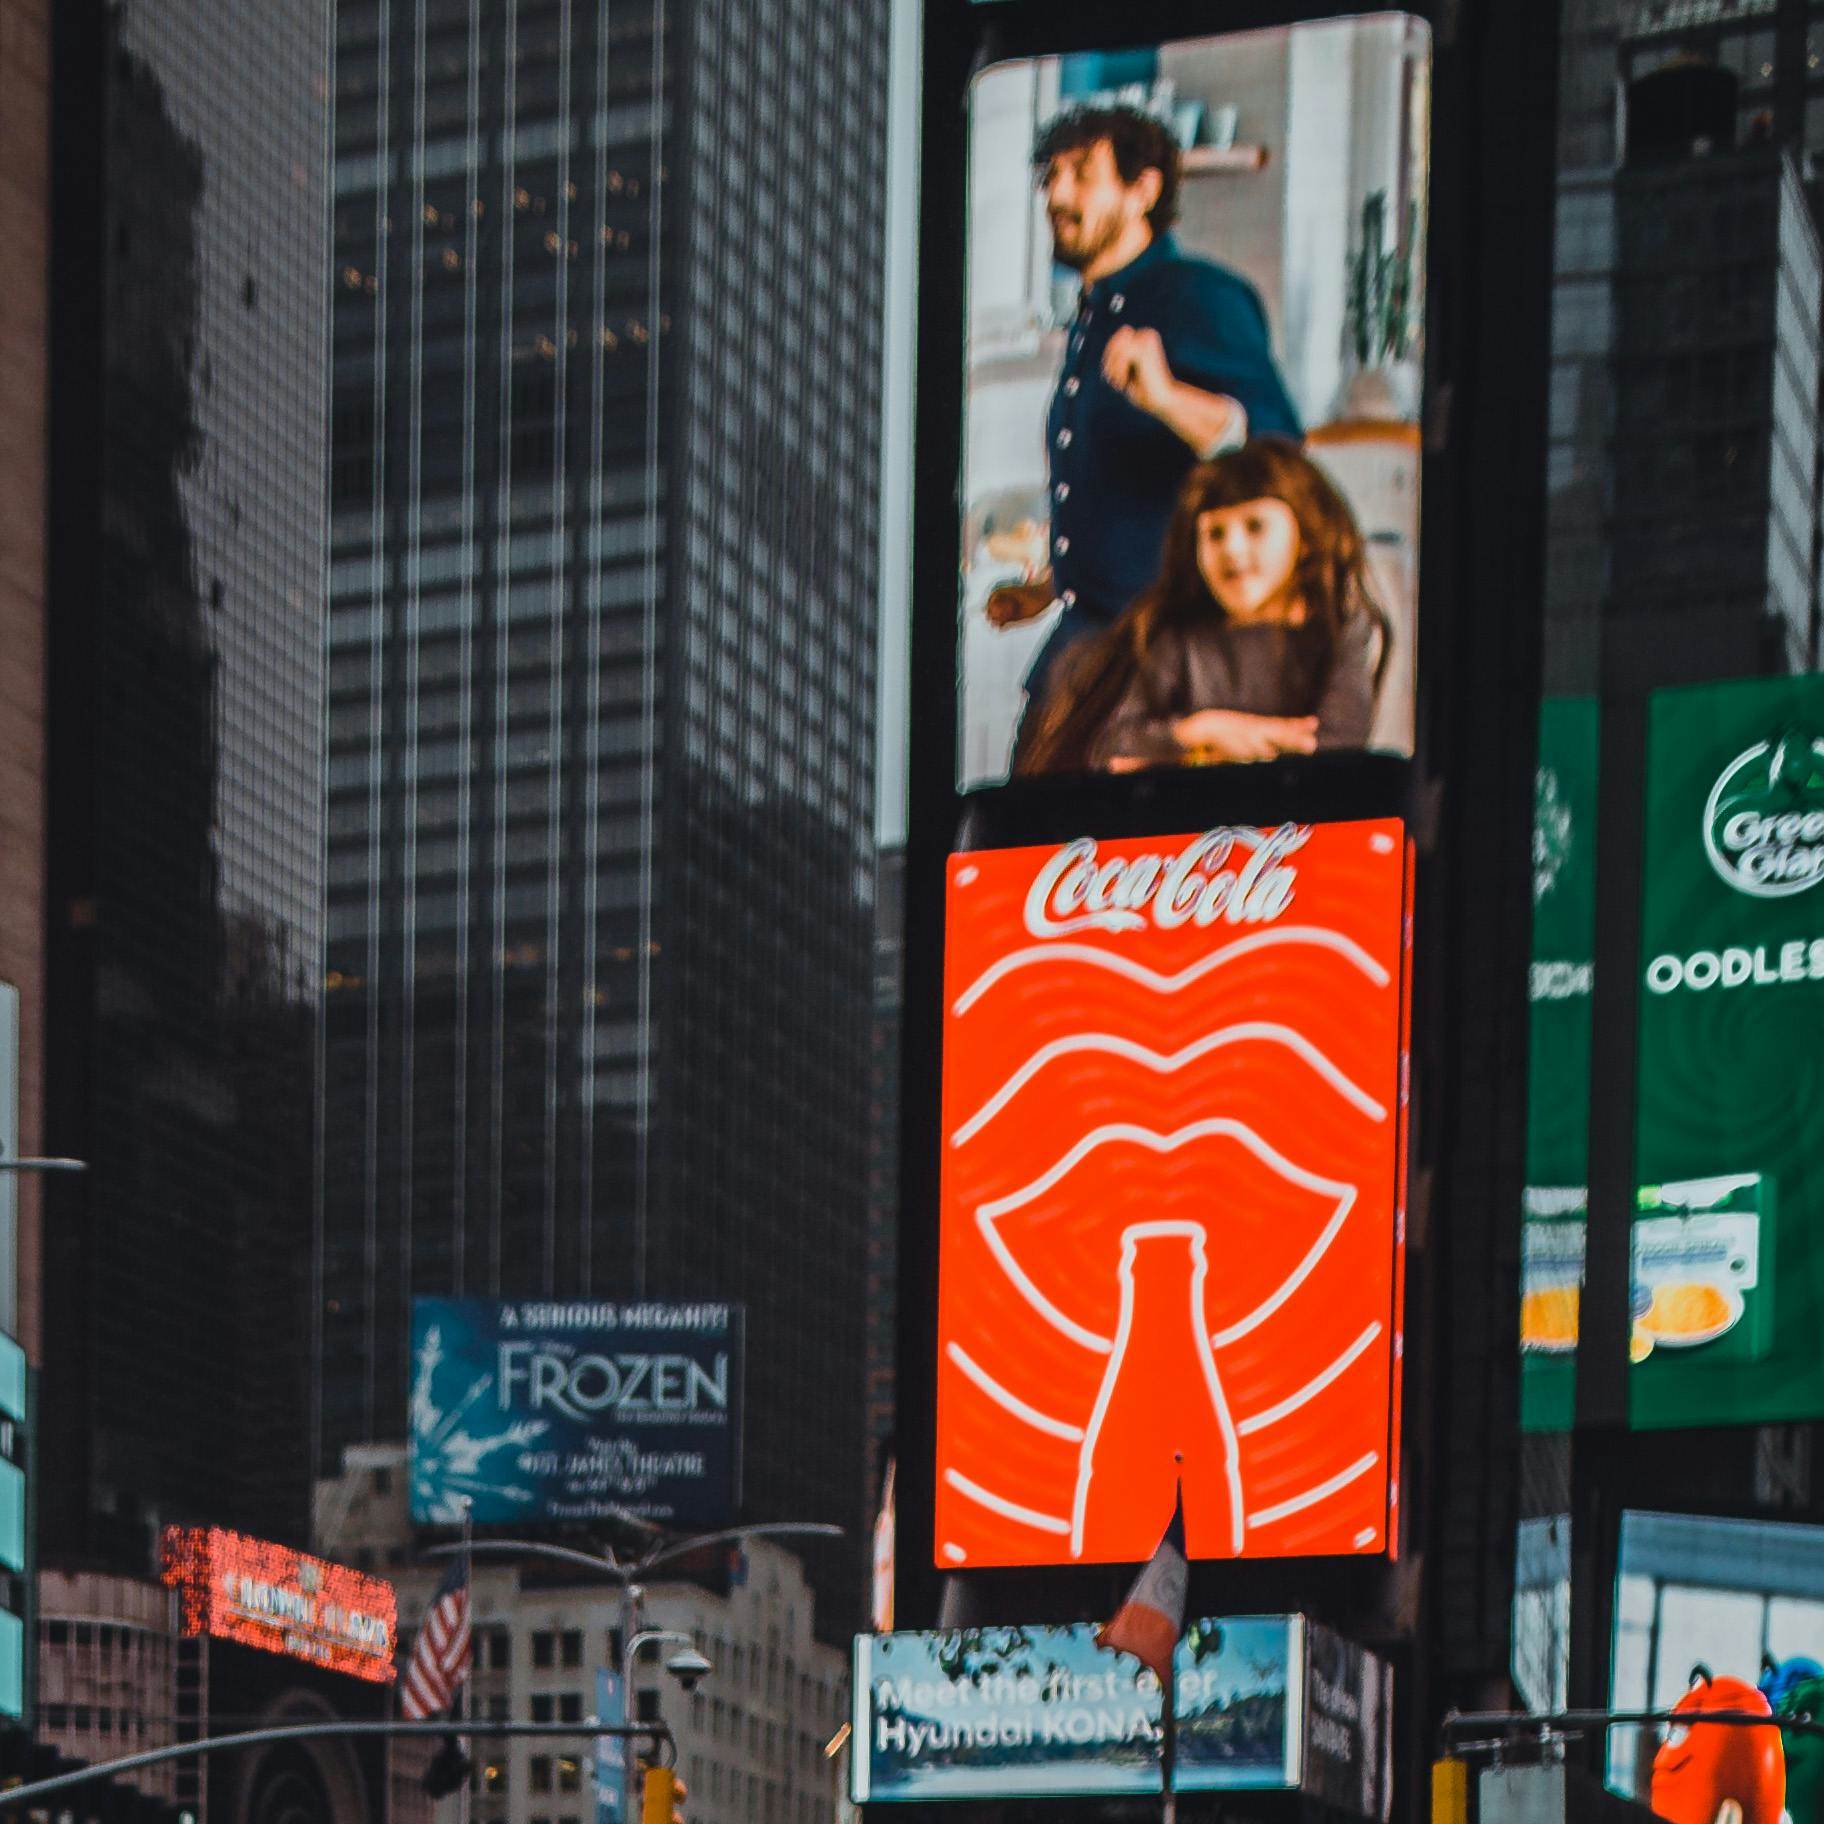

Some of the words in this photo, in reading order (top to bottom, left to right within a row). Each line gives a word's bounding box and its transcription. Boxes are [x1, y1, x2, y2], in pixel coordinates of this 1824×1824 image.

[498, 1340, 728, 1423] FROZEN
[878, 1674, 973, 1709] Meet
[979, 1672, 1042, 1702] the
[1049, 1667, 1218, 1703] first-eer
[878, 1713, 1032, 1758] Hyundai
